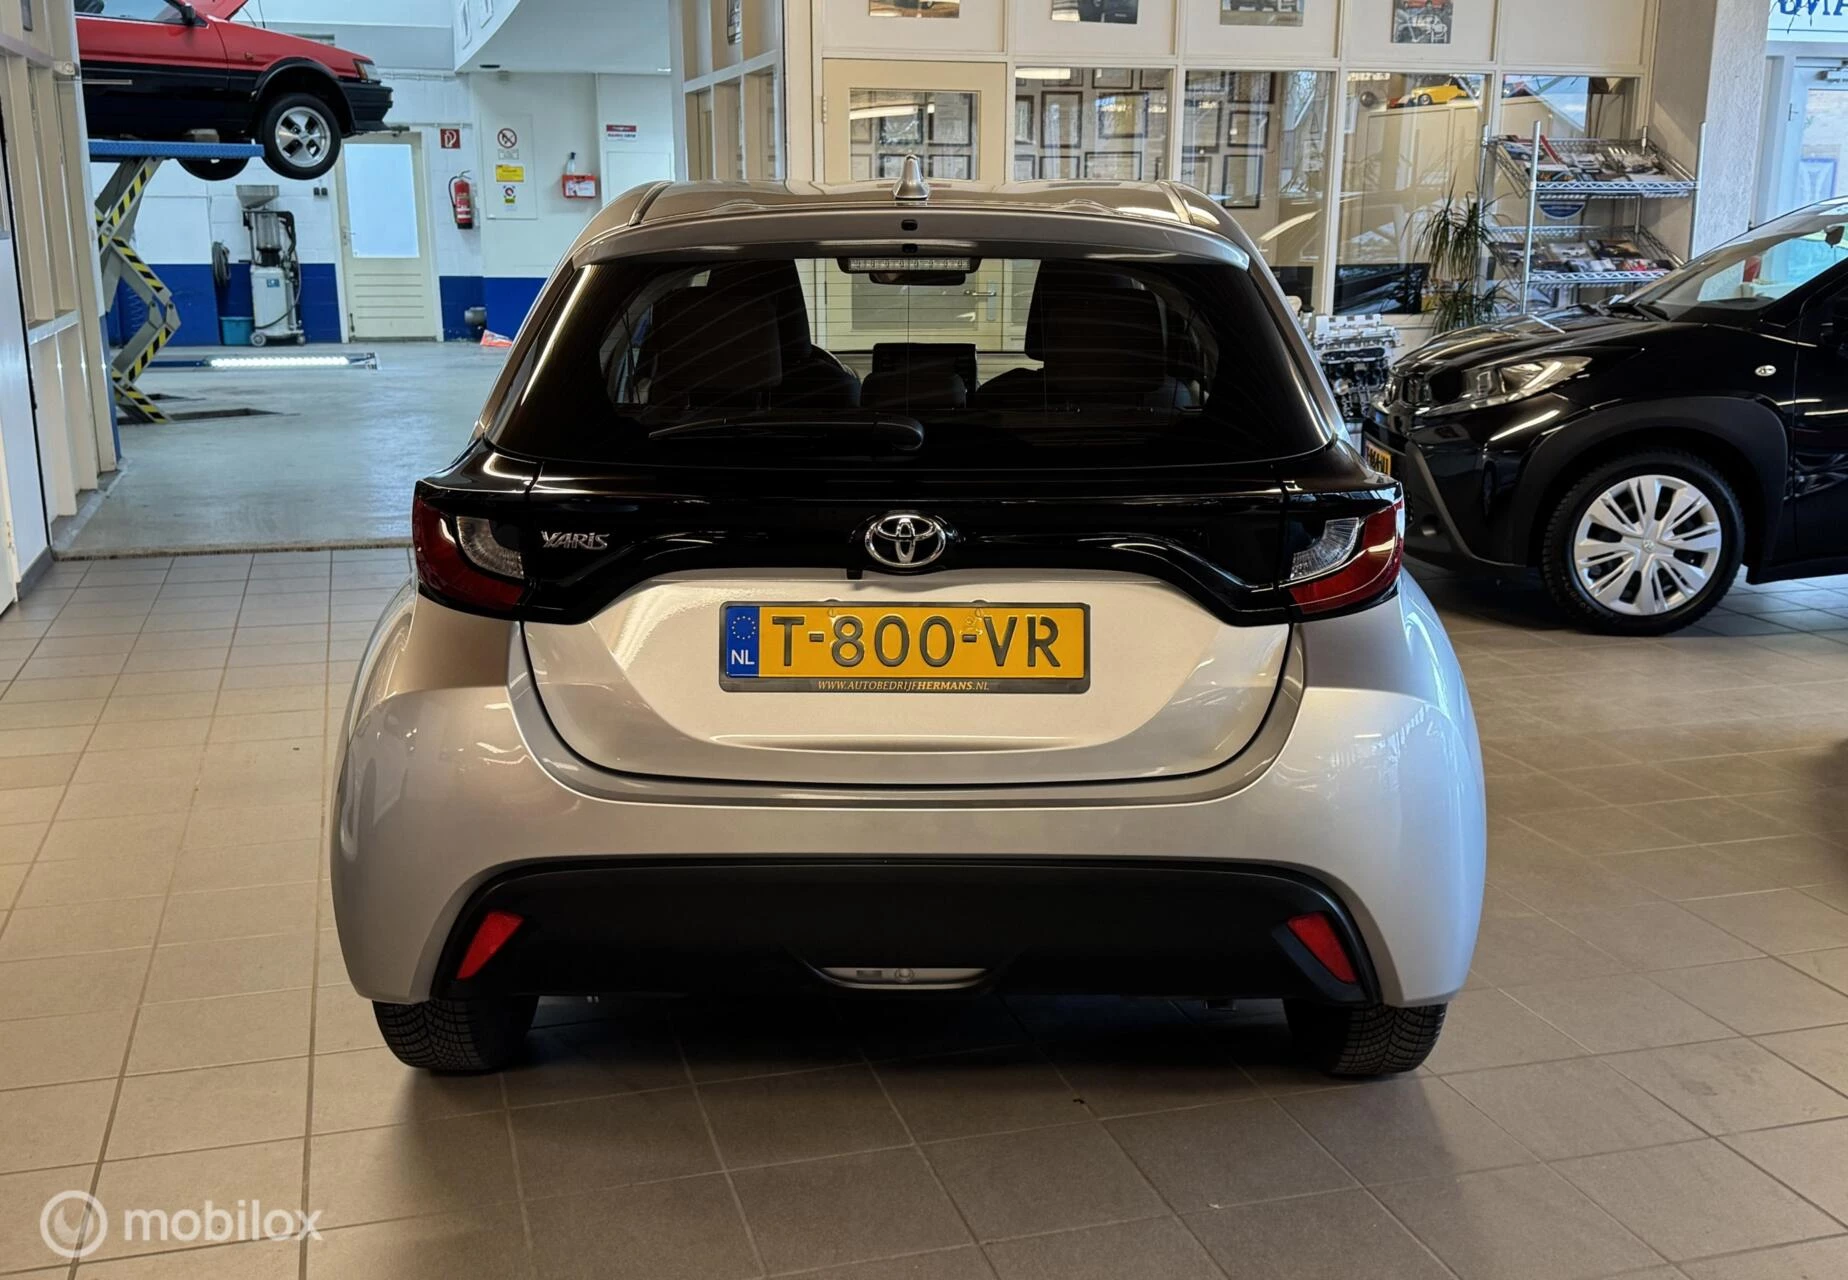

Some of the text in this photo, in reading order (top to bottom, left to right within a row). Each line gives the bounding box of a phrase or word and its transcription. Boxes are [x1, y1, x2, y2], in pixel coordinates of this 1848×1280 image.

[540, 530, 610, 550] YARIS
[772, 615, 1061, 668] T-800-VR
[731, 649, 755, 665] NL
[818, 680, 990, 692] WWW.AUTOBEDRIJFHERMANS.NL
